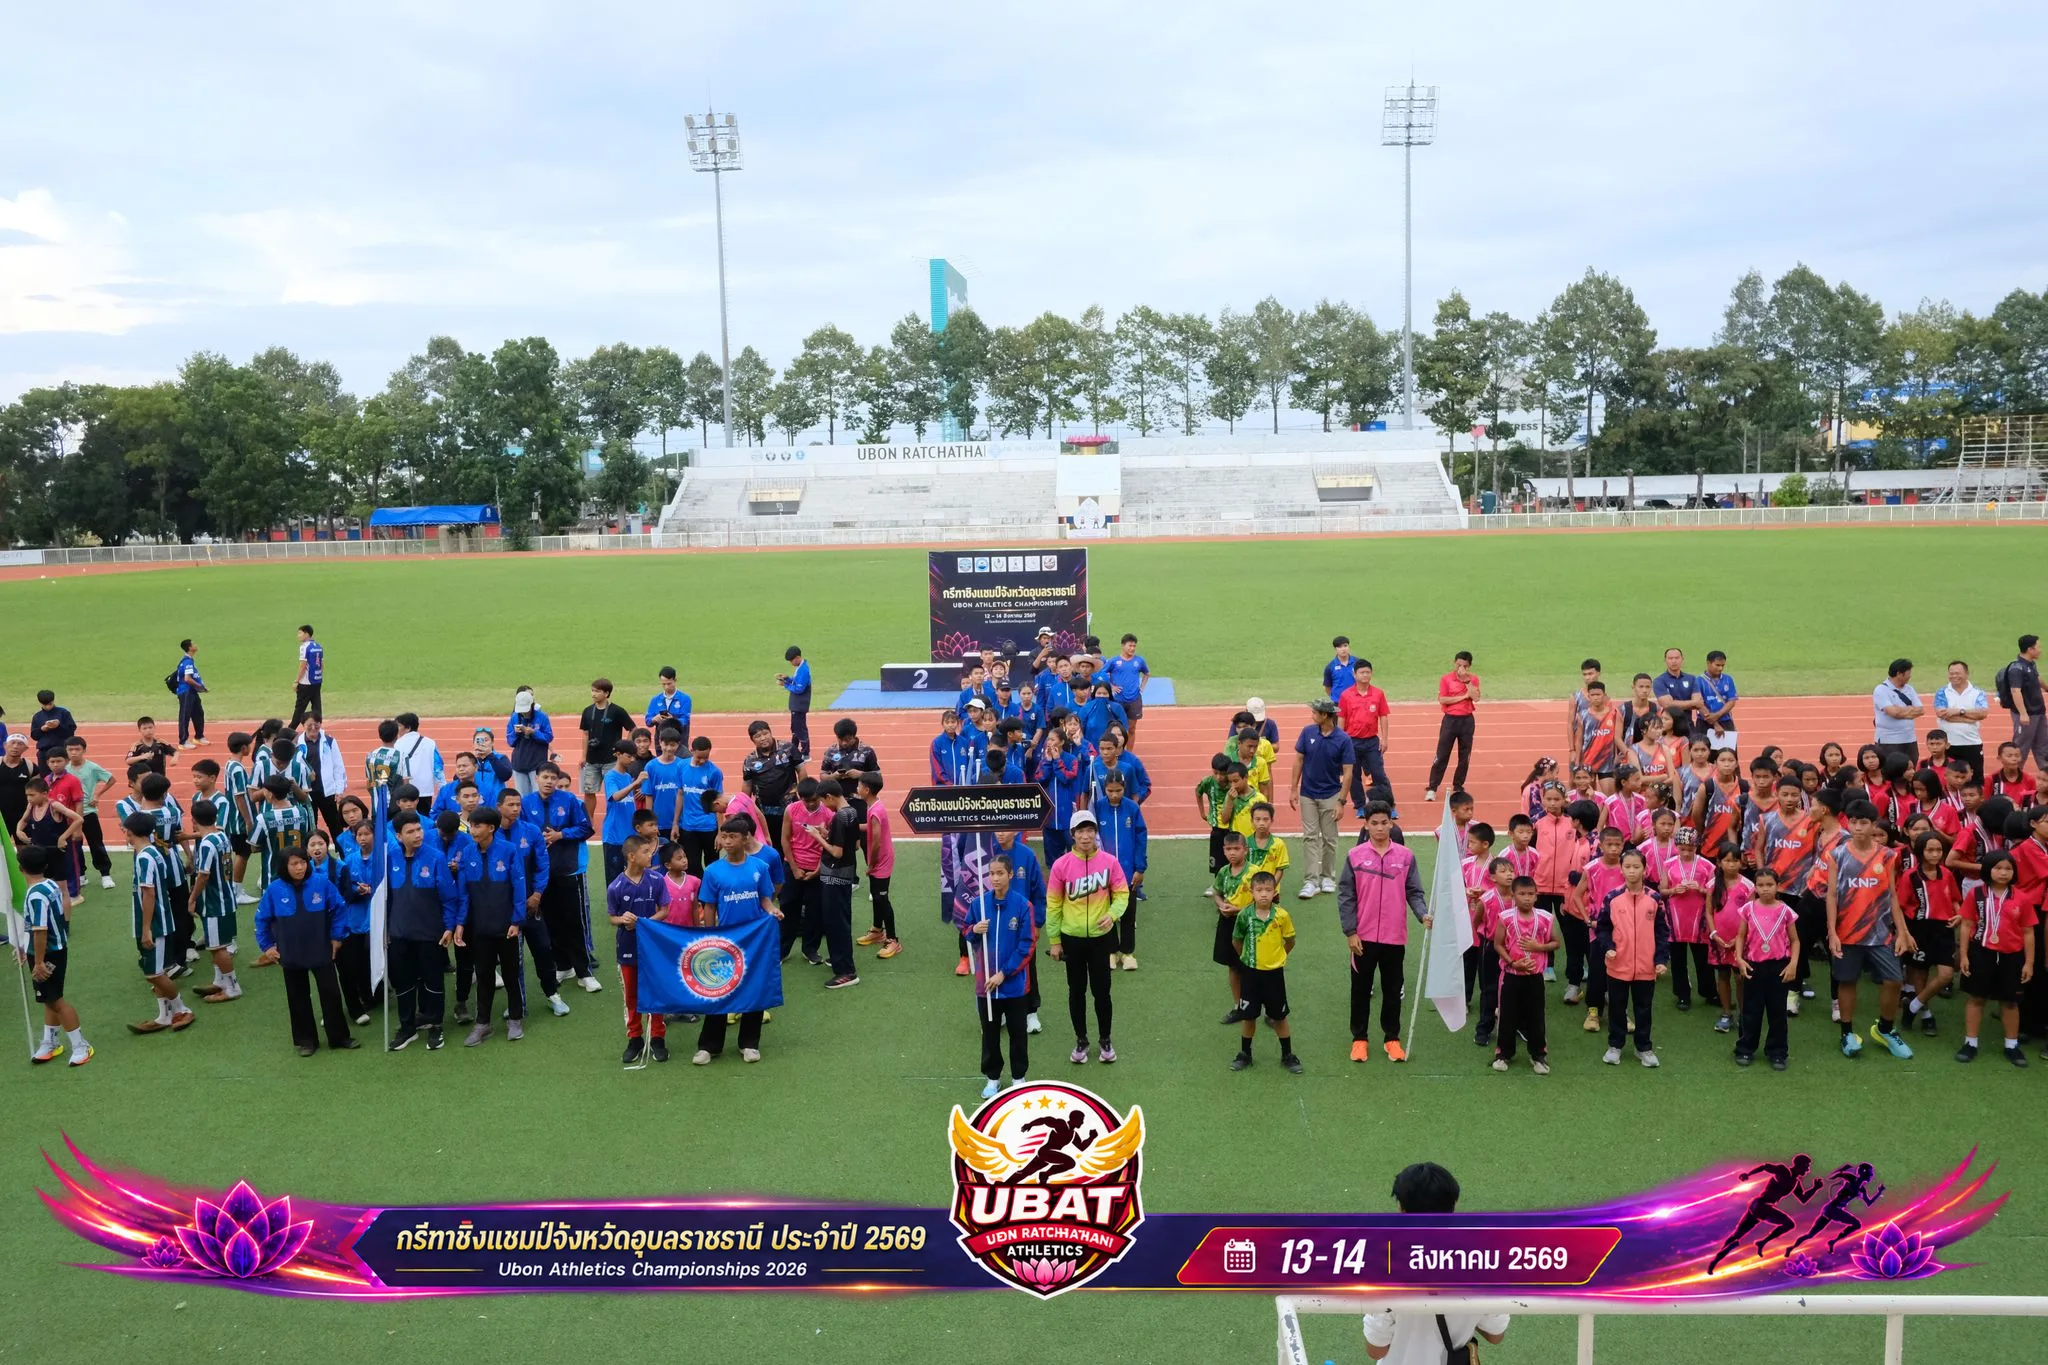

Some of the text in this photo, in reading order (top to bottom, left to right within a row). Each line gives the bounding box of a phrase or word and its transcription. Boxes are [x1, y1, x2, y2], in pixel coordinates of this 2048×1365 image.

[858, 447, 897, 460] UBON
[912, 669, 929, 689] 2
[1591, 728, 1611, 737] KNP
[1643, 764, 1665, 773] KNP
[908, 794, 1042, 813] กรีฑาชิงแชมป์จังหวัดอุบลราชธานี
[1713, 804, 1733, 814] KN
[981, 813, 1039, 821] CHAMPIONSHIPS
[1774, 838, 1802, 850] KNP
[1066, 868, 1111, 900] UBN
[1848, 877, 1879, 889] KNP
